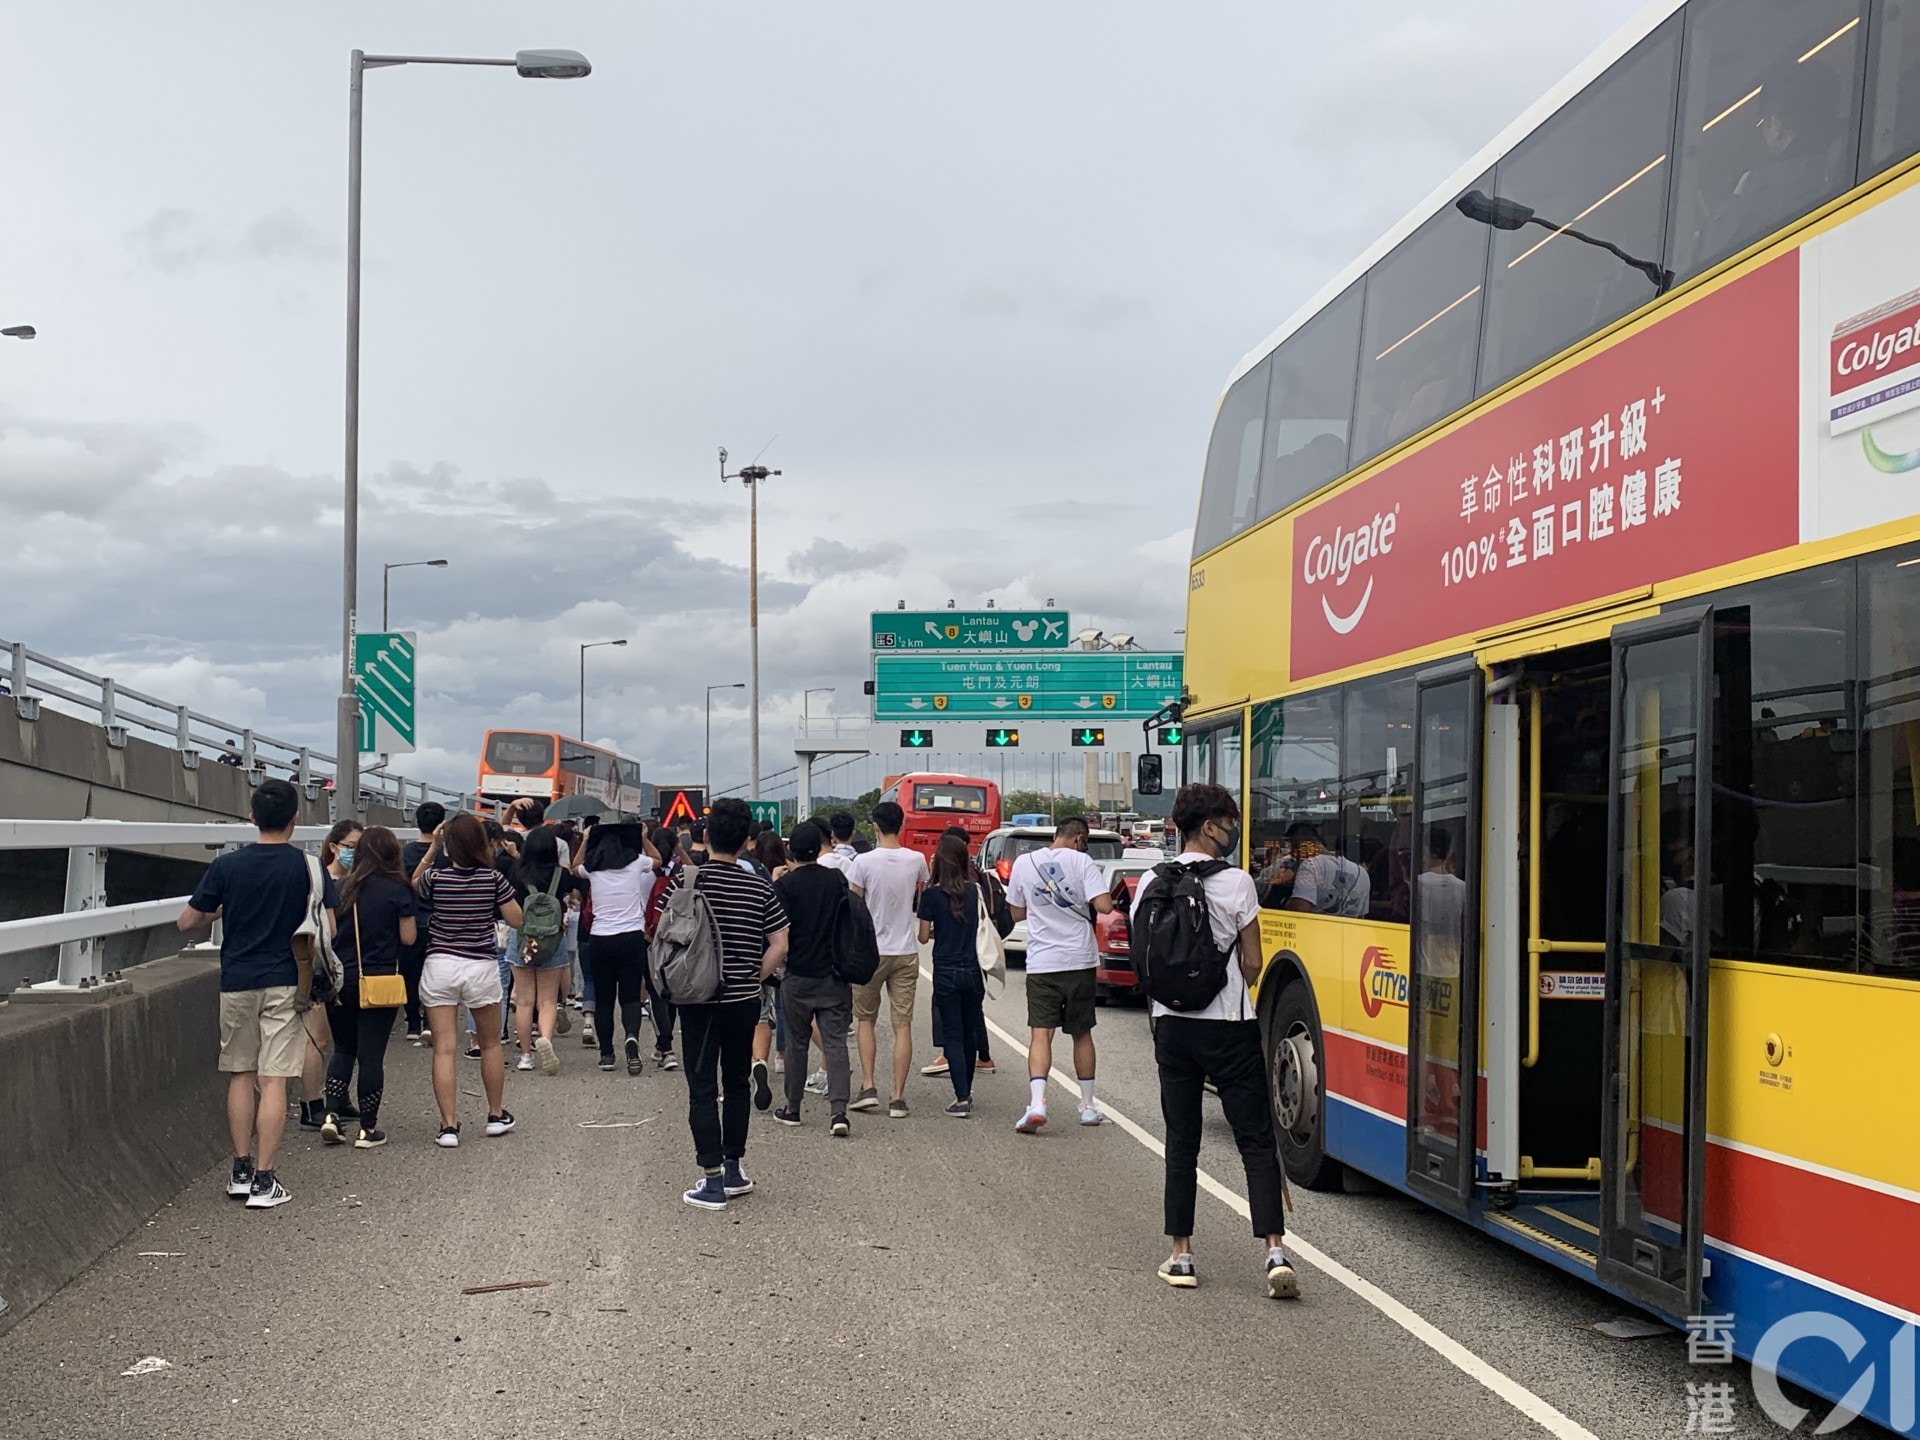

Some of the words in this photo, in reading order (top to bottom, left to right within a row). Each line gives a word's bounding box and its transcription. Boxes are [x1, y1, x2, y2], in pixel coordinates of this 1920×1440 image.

[1837, 318, 1920, 376] Colgat
[1303, 511, 1397, 586] Colgate
[962, 615, 1000, 626] Lantau
[886, 634, 894, 646] 5
[907, 638, 924, 648] km
[963, 630, 1008, 644] 大嶼山
[940, 661, 967, 671] Tuen
[969, 661, 993, 671] Mun
[995, 661, 1004, 672] &
[1006, 661, 1033, 671] Yuen
[1035, 660, 1061, 672] Long
[1136, 659, 1173, 670] Lantau
[962, 675, 1040, 689] 屯門及元朗
[1130, 674, 1176, 688] 大嶼山
[1372, 970, 1409, 1002] CITYB
